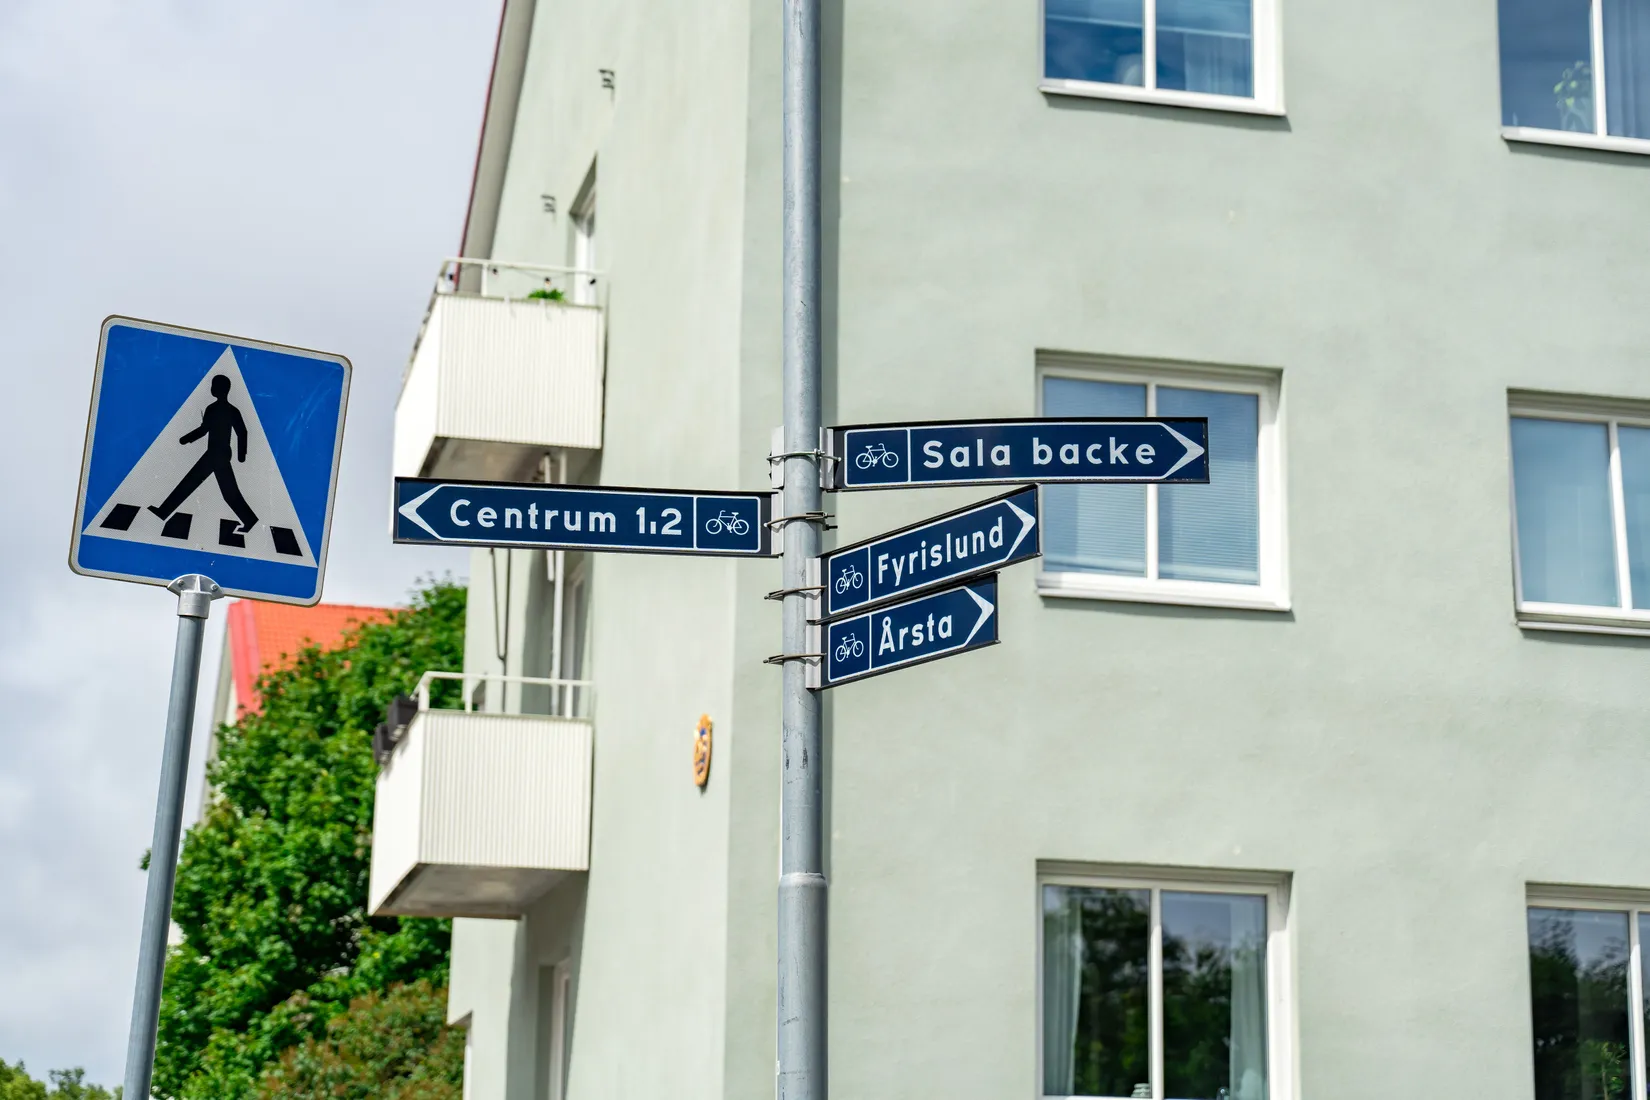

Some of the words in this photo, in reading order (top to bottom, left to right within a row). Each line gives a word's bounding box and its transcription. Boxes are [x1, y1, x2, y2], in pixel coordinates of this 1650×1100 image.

[923, 438, 1011, 469] Sala
[1032, 436, 1156, 466] backe
[448, 498, 616, 533] Centrum
[878, 516, 1003, 587] Fyrislund
[878, 613, 954, 656] Årsta
